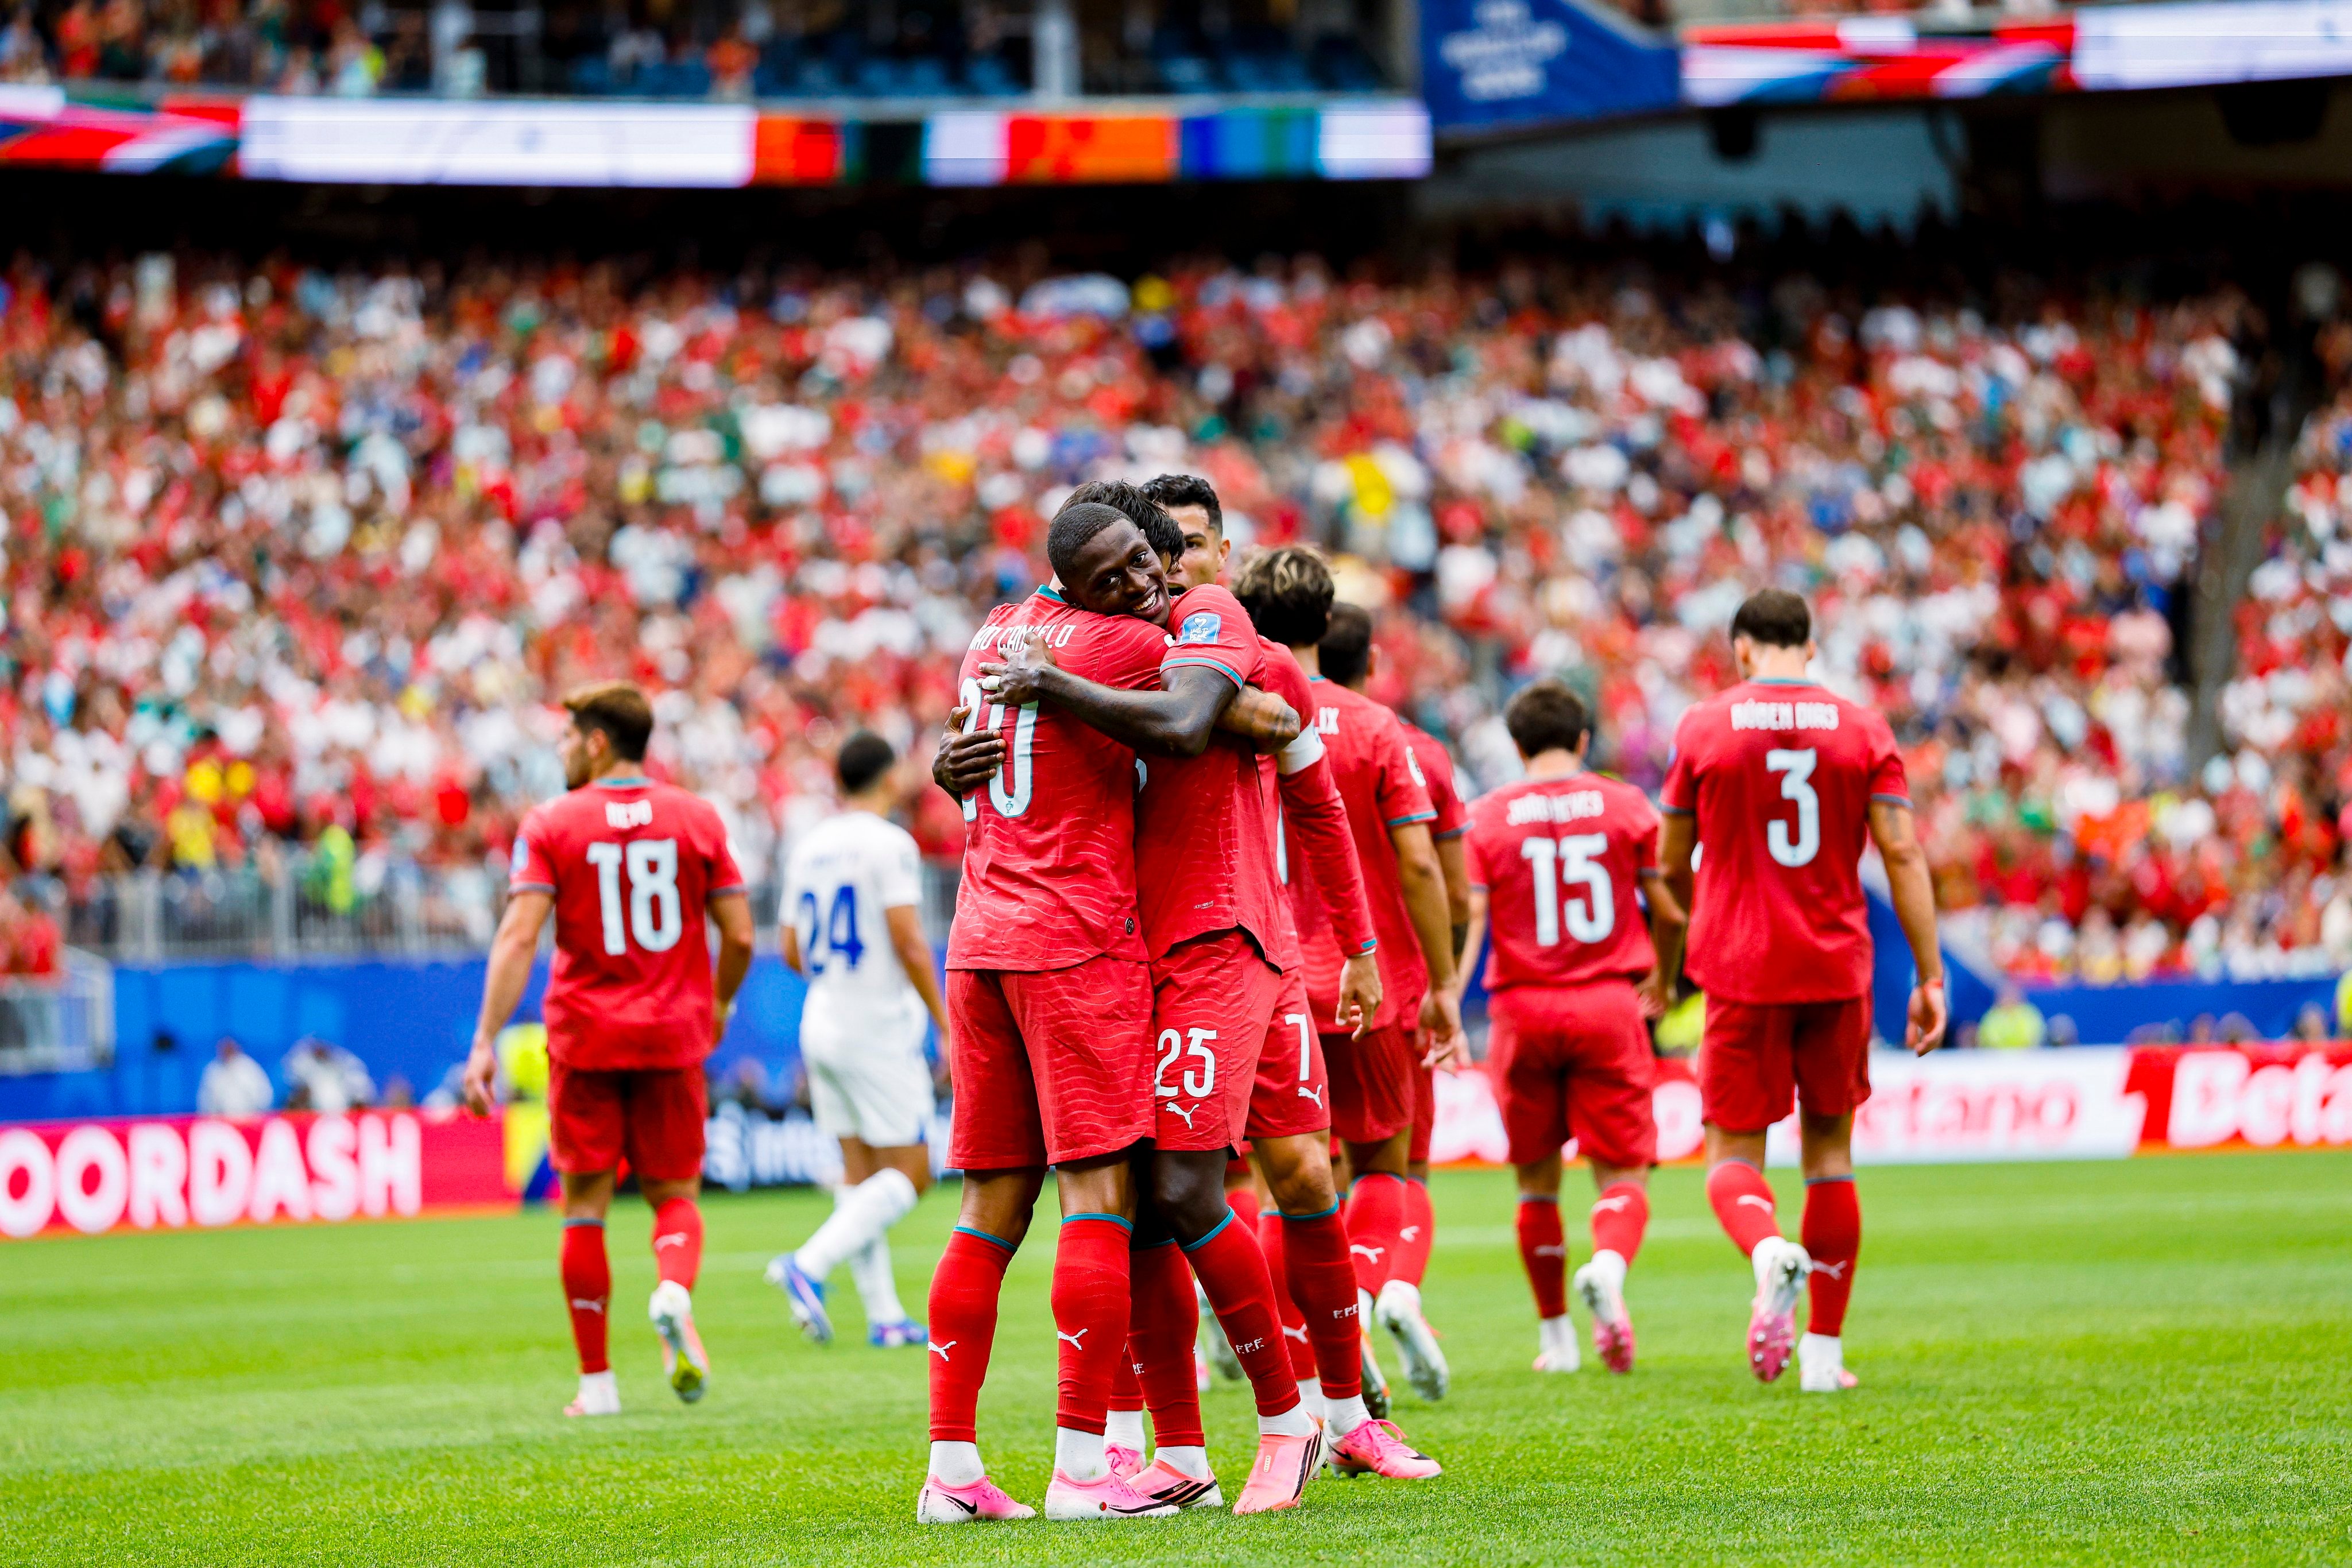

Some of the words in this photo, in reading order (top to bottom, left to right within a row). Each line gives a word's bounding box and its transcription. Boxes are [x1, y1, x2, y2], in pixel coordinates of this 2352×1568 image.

[960, 676, 1038, 822] 20
[1766, 748, 1820, 868] 3
[587, 838, 682, 955] 18
[801, 885, 864, 975] 24
[1521, 832, 1614, 946] 15
[1155, 1027, 1217, 1098] 25
[1285, 1013, 1310, 1081] 7
[1236, 1337, 1264, 1354] F.P.F.
